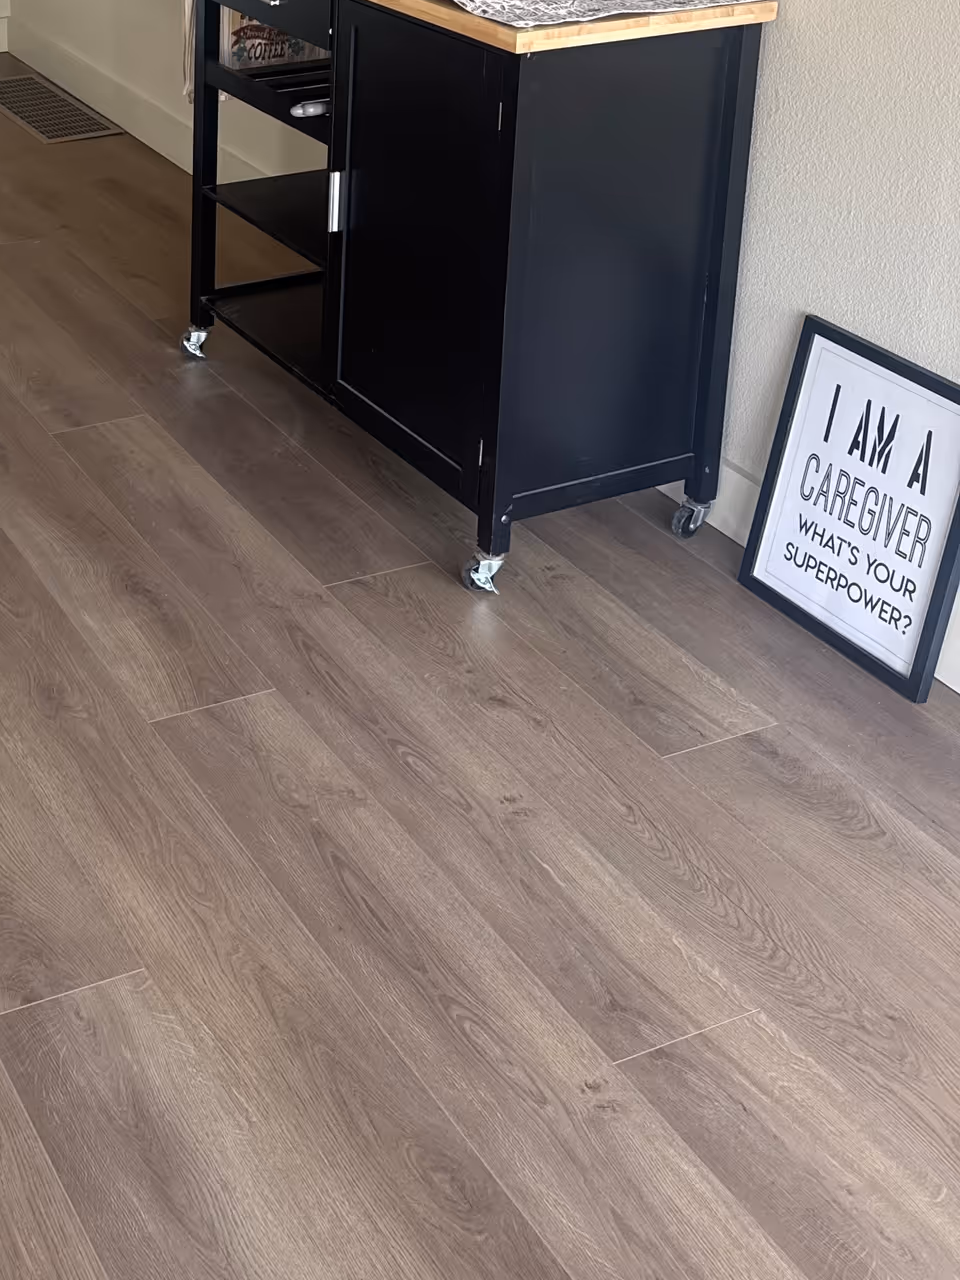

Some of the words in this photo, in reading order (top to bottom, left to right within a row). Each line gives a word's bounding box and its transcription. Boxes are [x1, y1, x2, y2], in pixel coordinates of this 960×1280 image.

[248, 42, 286, 60] COFFEE
[823, 384, 841, 442] I
[847, 399, 900, 474] AM
[907, 430, 933, 496] A
[800, 453, 932, 568] CAREGIVER
[783, 542, 912, 635] SUPERPOWER?
[799, 513, 860, 566] WHAT'S
[866, 553, 916, 602] YOUR
